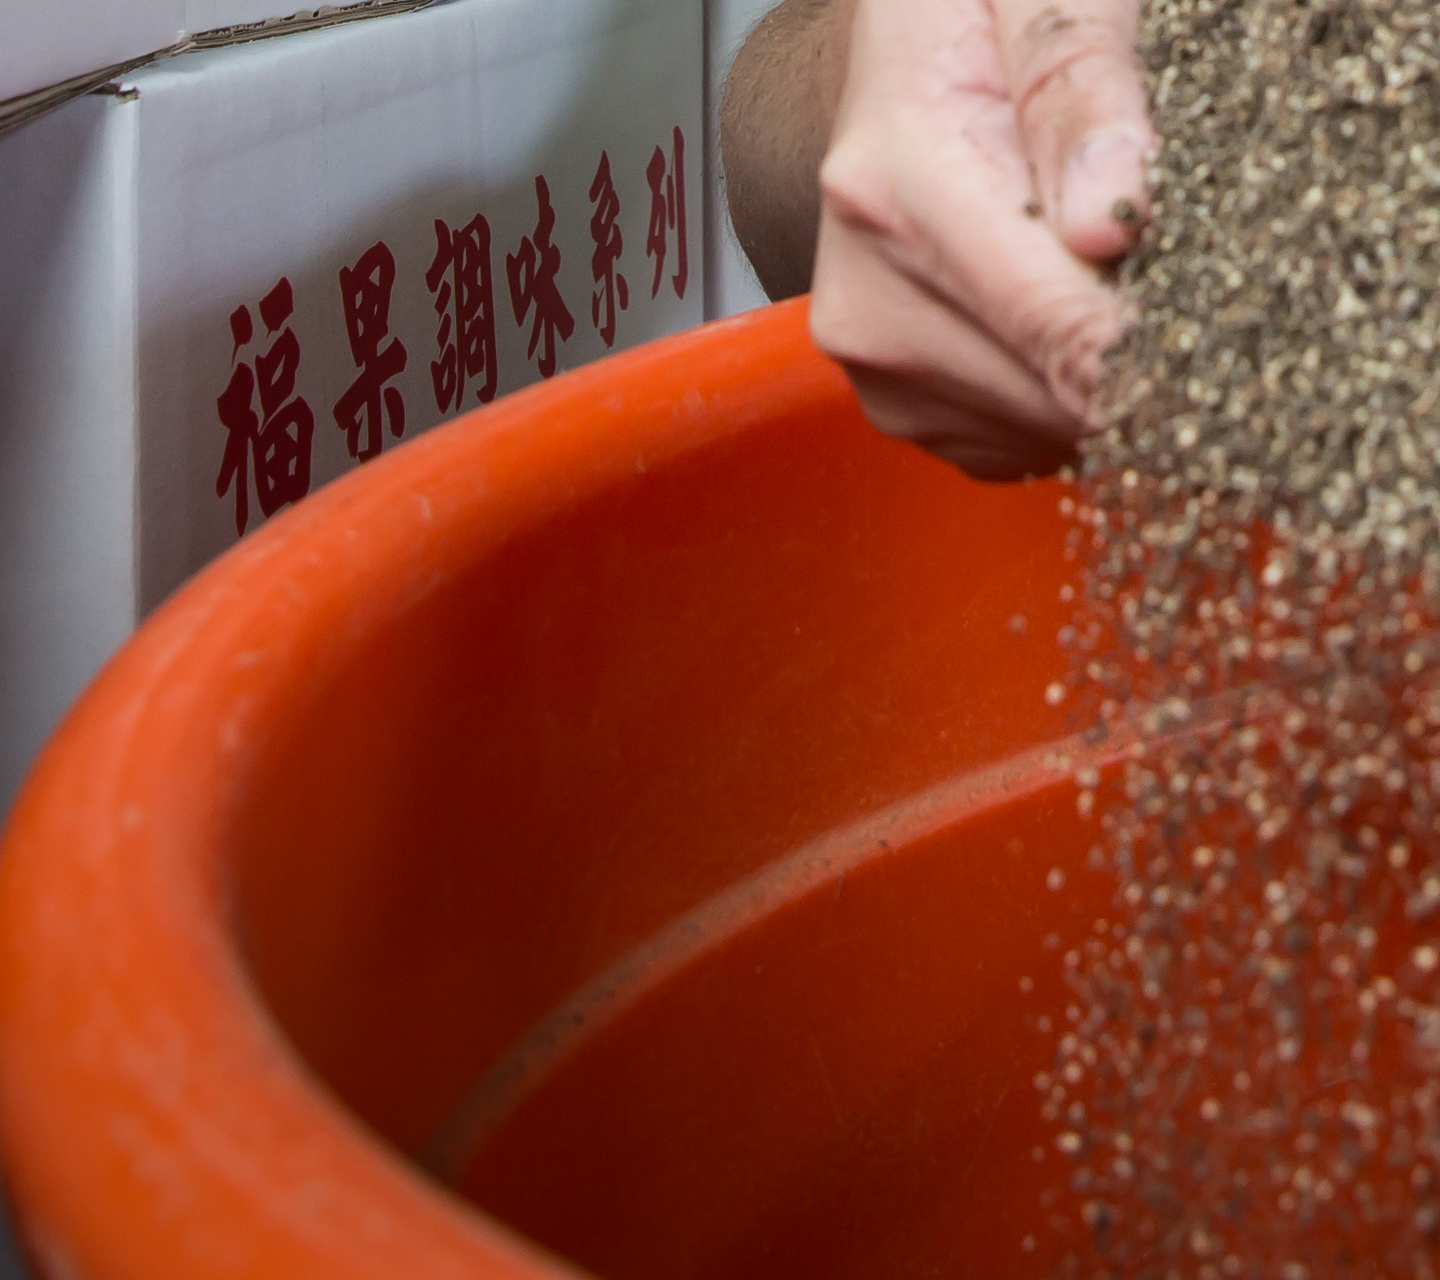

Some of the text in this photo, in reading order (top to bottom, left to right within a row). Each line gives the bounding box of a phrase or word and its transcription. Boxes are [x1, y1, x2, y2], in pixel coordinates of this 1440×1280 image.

[215, 125, 690, 538] 福果調味系列
